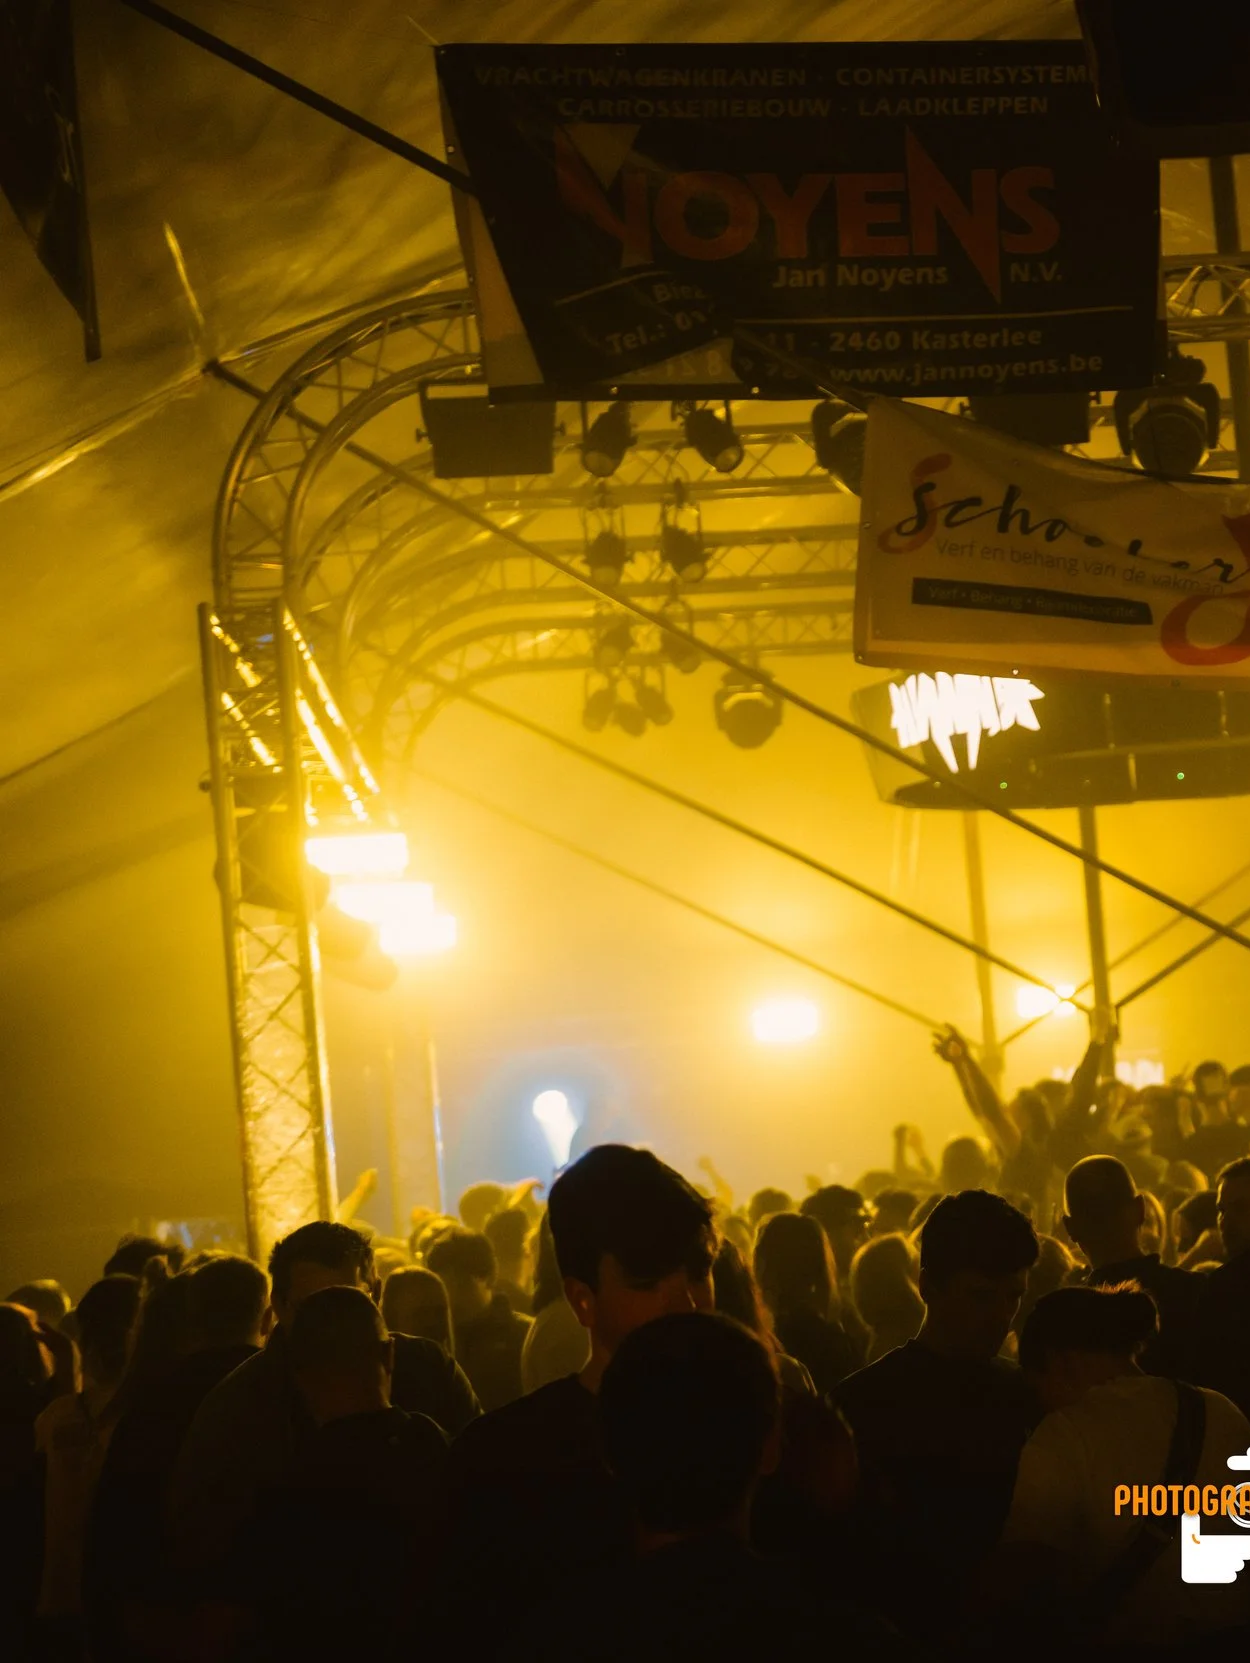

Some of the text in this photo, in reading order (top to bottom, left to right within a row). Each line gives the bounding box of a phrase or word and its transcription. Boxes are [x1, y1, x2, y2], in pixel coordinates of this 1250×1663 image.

[474, 63, 1090, 89] VRACHTWAGENKRANEN CONTAINERSYSTEM
[556, 95, 1049, 119] CARROSSERIEBOUW LAADKLEPPEN
[772, 260, 1064, 292] Jan Noyens N.V.
[828, 330, 902, 353] 2460
[911, 326, 1044, 351] Kasterlee
[829, 353, 1105, 388] www.jannoyens.be
[936, 537, 1224, 595] Verf en behang van de vakman
